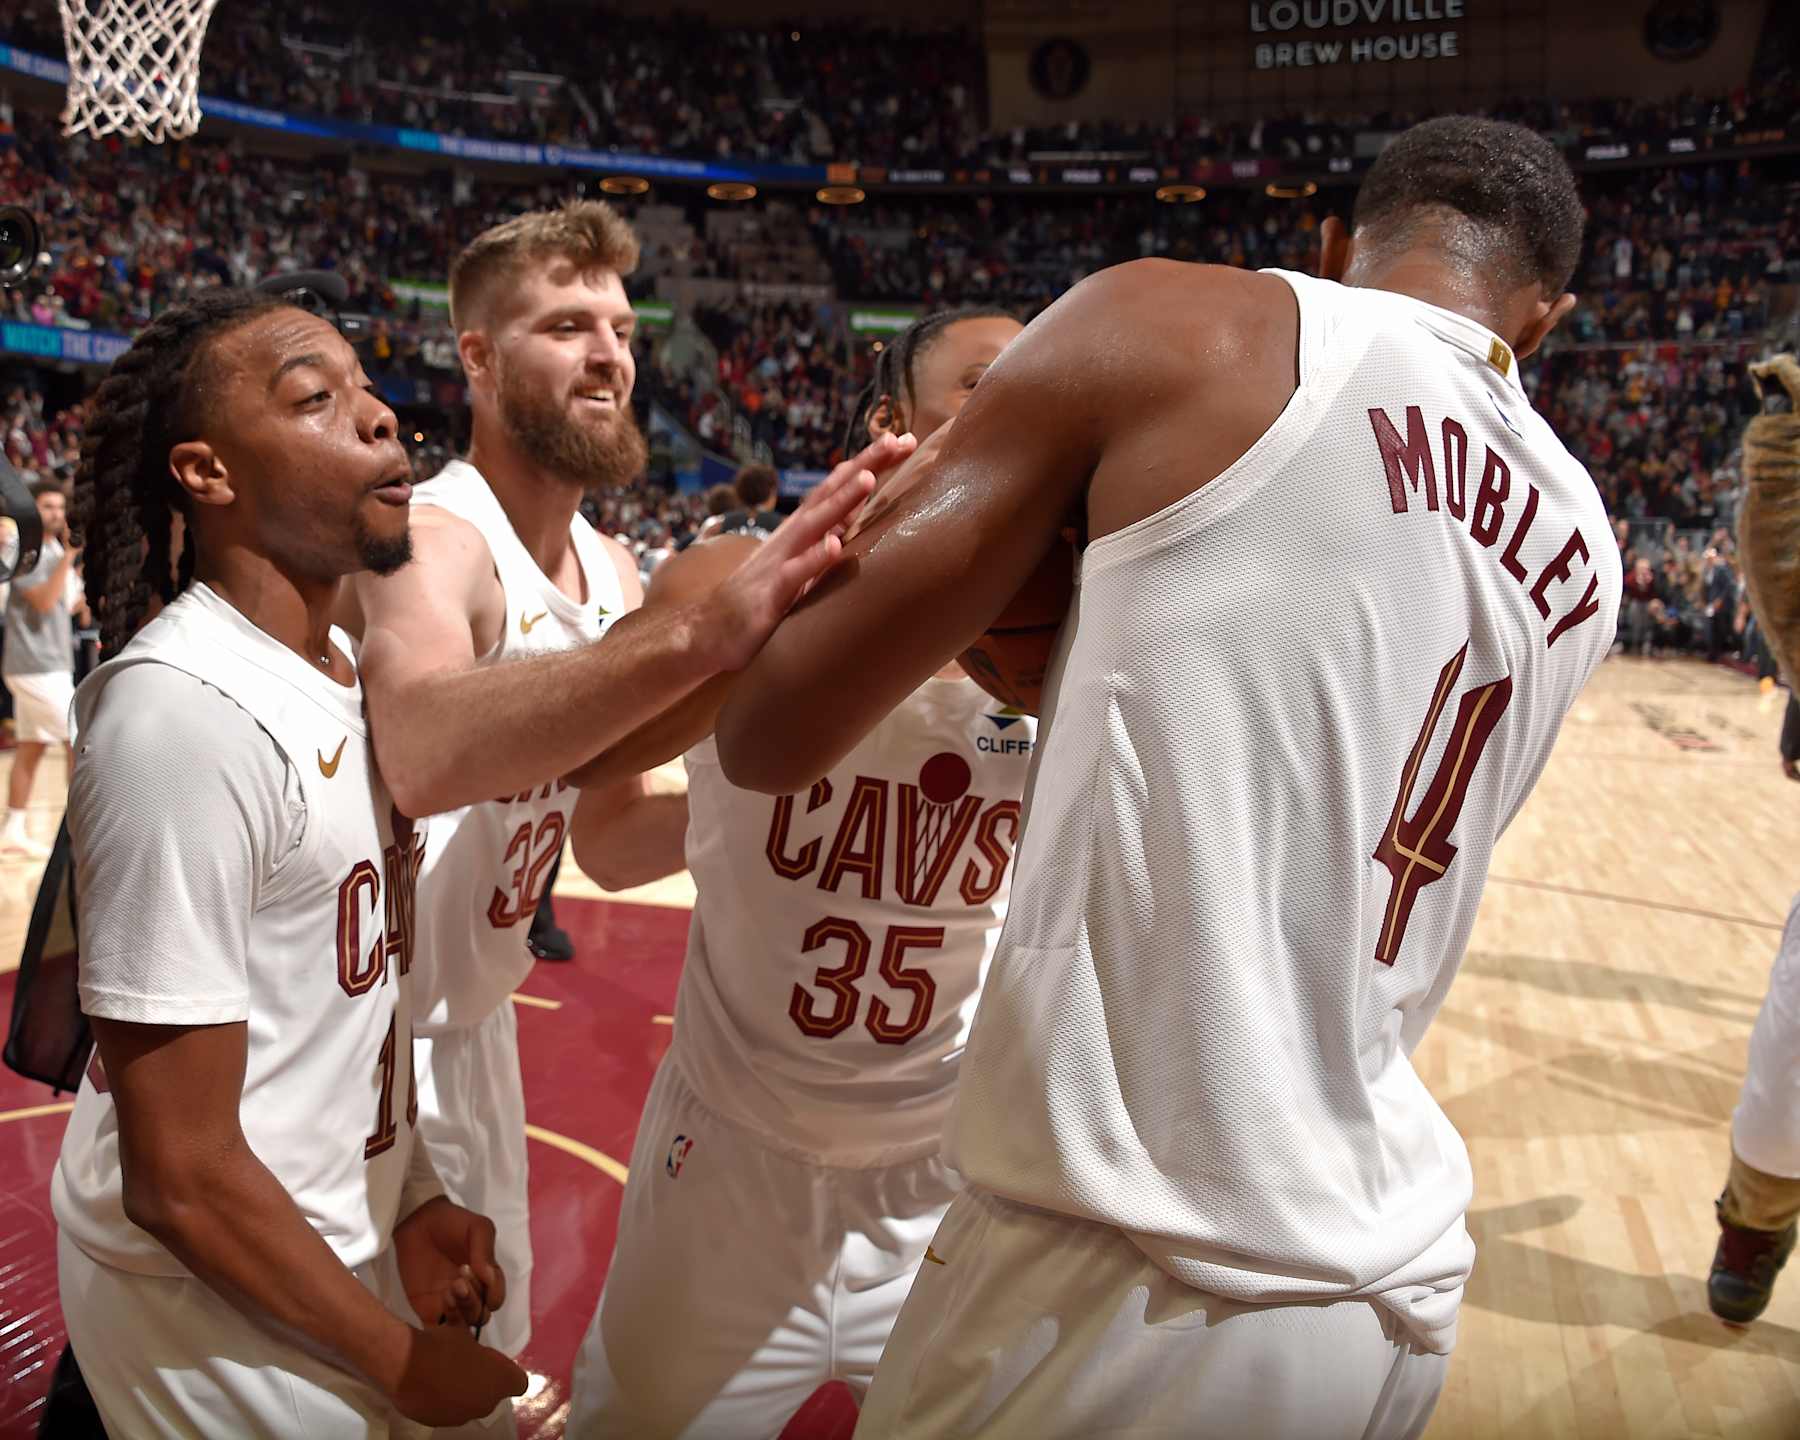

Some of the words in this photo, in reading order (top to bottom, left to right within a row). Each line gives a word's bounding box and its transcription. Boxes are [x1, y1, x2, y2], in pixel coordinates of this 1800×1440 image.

[1250, 0, 1464, 32] LOUDVILLE
[1255, 41, 1343, 69] BREW
[1351, 31, 1459, 63] HOUSE
[1368, 405, 1600, 649] MOBLEY
[976, 736, 1038, 755] CLIFF
[1372, 639, 1513, 967] 4
[487, 810, 565, 928] 32
[765, 775, 1021, 907] CAVS
[788, 915, 945, 1045] 35
